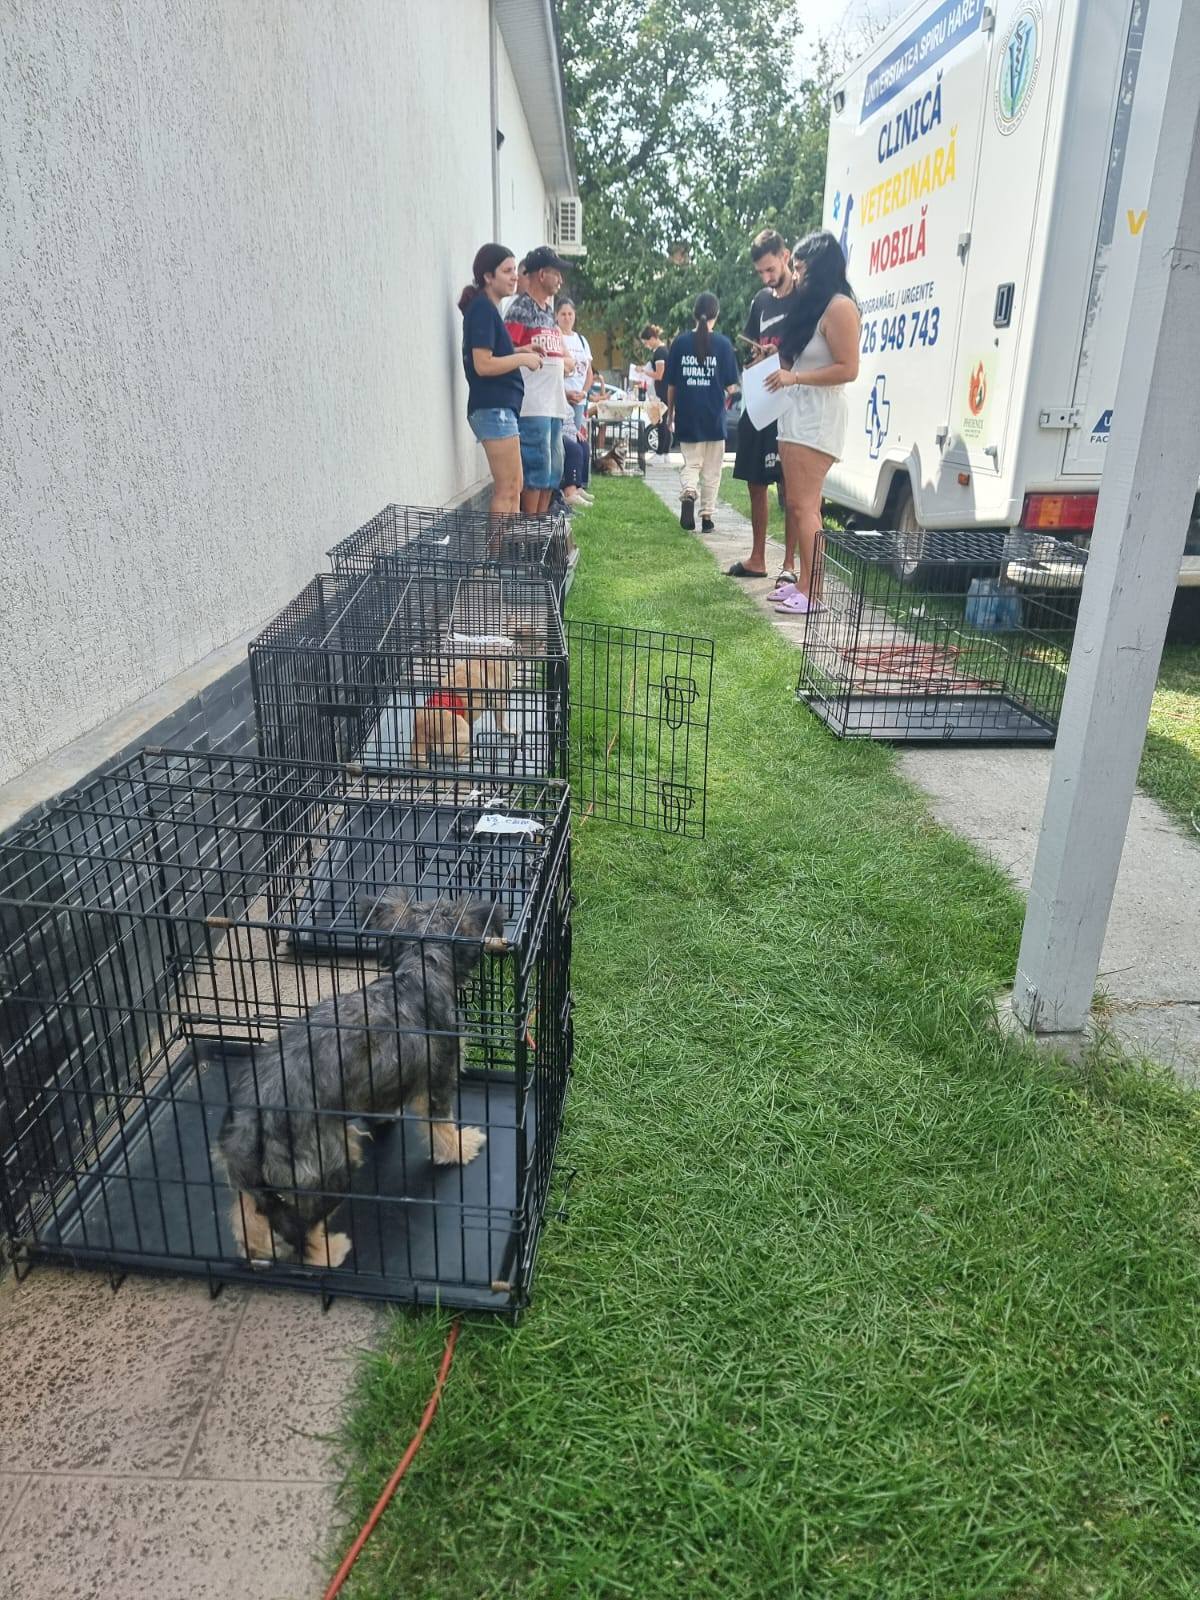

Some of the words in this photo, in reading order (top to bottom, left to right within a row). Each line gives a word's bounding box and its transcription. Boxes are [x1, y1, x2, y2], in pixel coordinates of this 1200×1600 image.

[864, 42, 920, 106] UNIVERSITATEA
[919, 16, 947, 60] SPIRU
[878, 66, 944, 164] CLINICĂ
[859, 123, 959, 228] VETERINARĂ
[868, 203, 928, 276] MOBILĂ
[1127, 208, 1148, 235] V
[860, 319, 877, 354] 26
[880, 313, 906, 352] 948
[909, 306, 940, 348] 743
[682, 366, 705, 377] RURAL
[706, 367, 715, 377] 21
[1090, 435, 1110, 444] FAC
